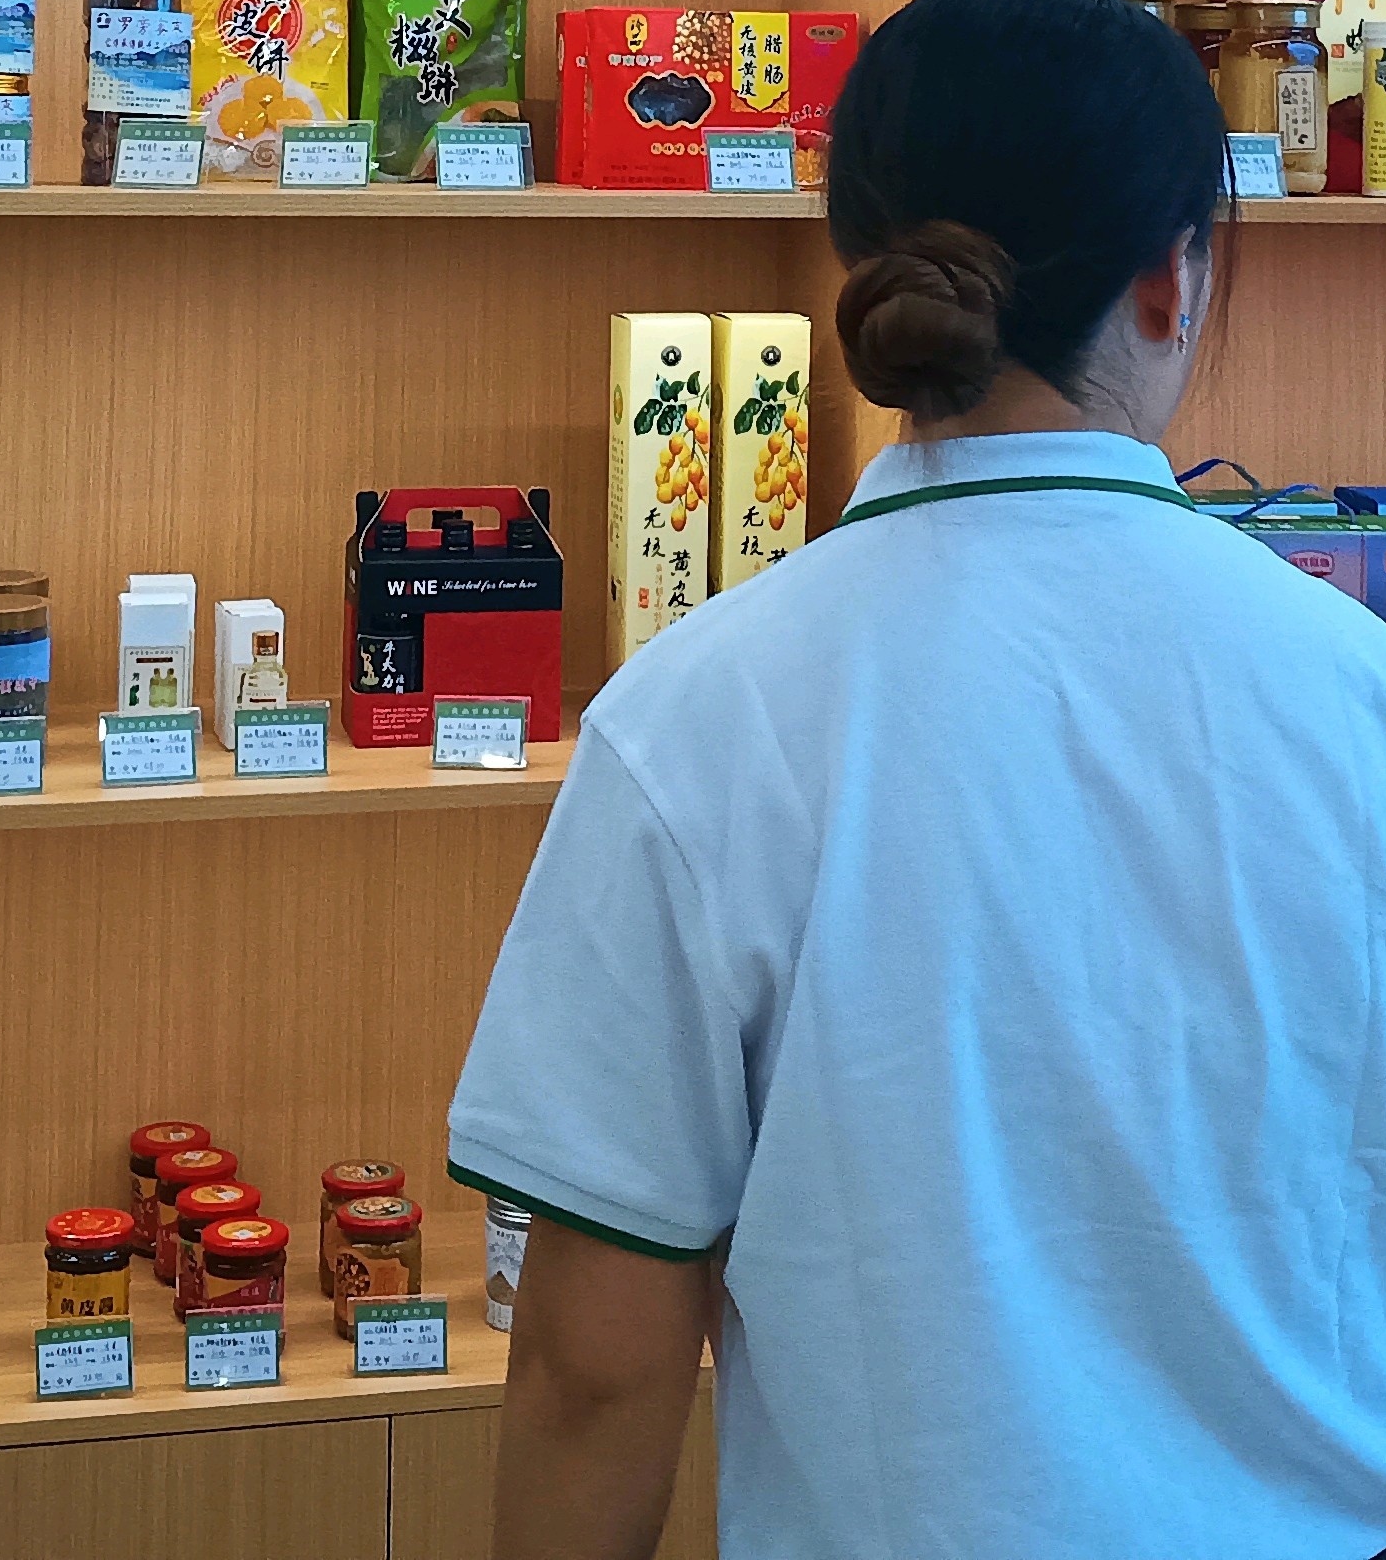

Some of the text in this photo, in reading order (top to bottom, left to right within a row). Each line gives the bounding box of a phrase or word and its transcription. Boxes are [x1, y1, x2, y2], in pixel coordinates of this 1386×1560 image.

[737, 24, 757, 97] 无核黄皮
[764, 34, 783, 84] 腊肠
[643, 507, 665, 557] 无核
[741, 505, 763, 555] 无核
[387, 579, 438, 595] WINE
[382, 641, 396, 688] 牛大力
